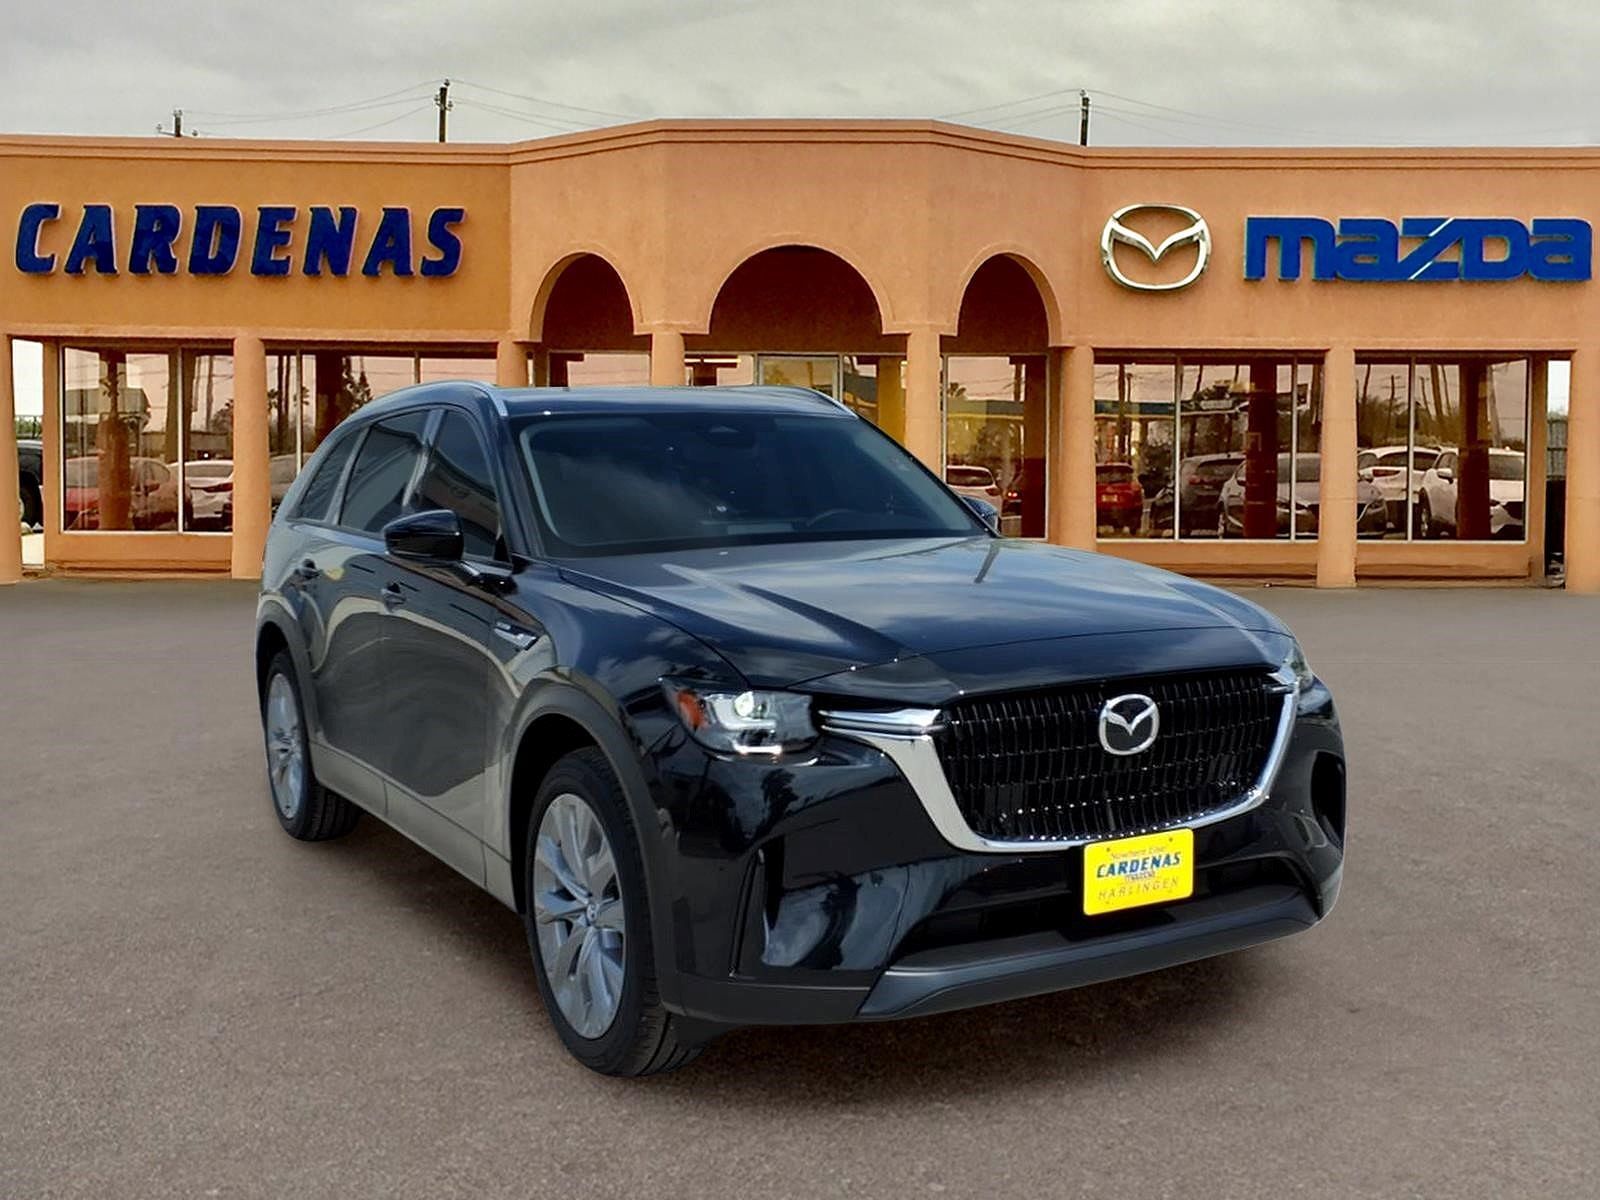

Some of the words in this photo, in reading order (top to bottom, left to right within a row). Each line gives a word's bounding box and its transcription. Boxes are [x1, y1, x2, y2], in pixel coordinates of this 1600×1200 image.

[14, 202, 467, 277] CARDENAS
[1243, 214, 1593, 283] mazda
[1096, 851, 1181, 879] CARDENAS
[1098, 876, 1179, 901] HARLINGEN
